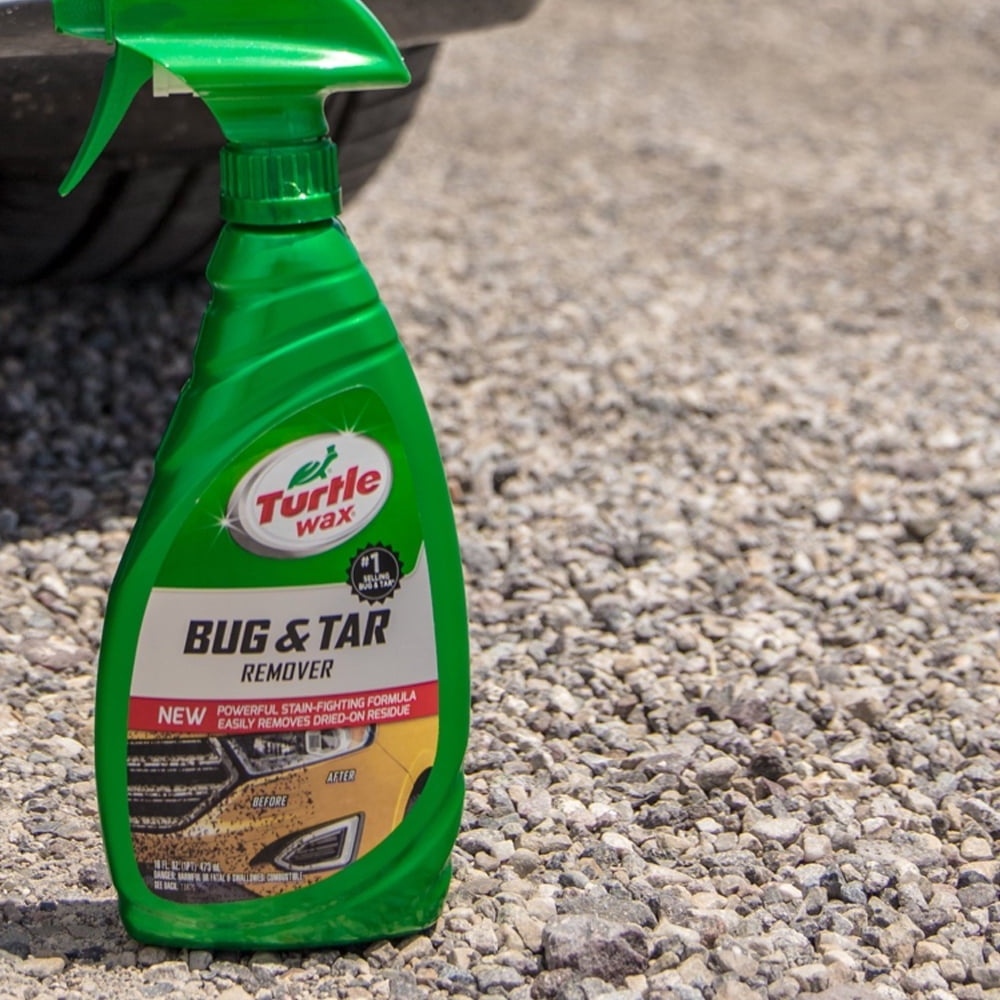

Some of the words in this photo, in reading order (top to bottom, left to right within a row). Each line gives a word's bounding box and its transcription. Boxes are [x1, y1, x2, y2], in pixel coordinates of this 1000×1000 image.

[256, 465, 382, 525] Turtle
[296, 505, 354, 538] wax
[361, 552, 380, 574] #1
[183, 620, 271, 655] BUG
[274, 618, 310, 653] &
[319, 608, 391, 651] TAR
[241, 659, 334, 683] REMOVER
[157, 706, 208, 726] NEW
[217, 704, 278, 717] POWERFUL
[281, 698, 365, 715] STAIN-FIGHTING
[367, 690, 417, 708] FORMULA
[217, 717, 254, 730] EASILY
[257, 715, 311, 729] REMOVES
[313, 712, 366, 727] DRIED-ON
[367, 704, 411, 721] RESIDUE
[326, 769, 357, 784] AFTER
[252, 795, 288, 808] BEFORE
